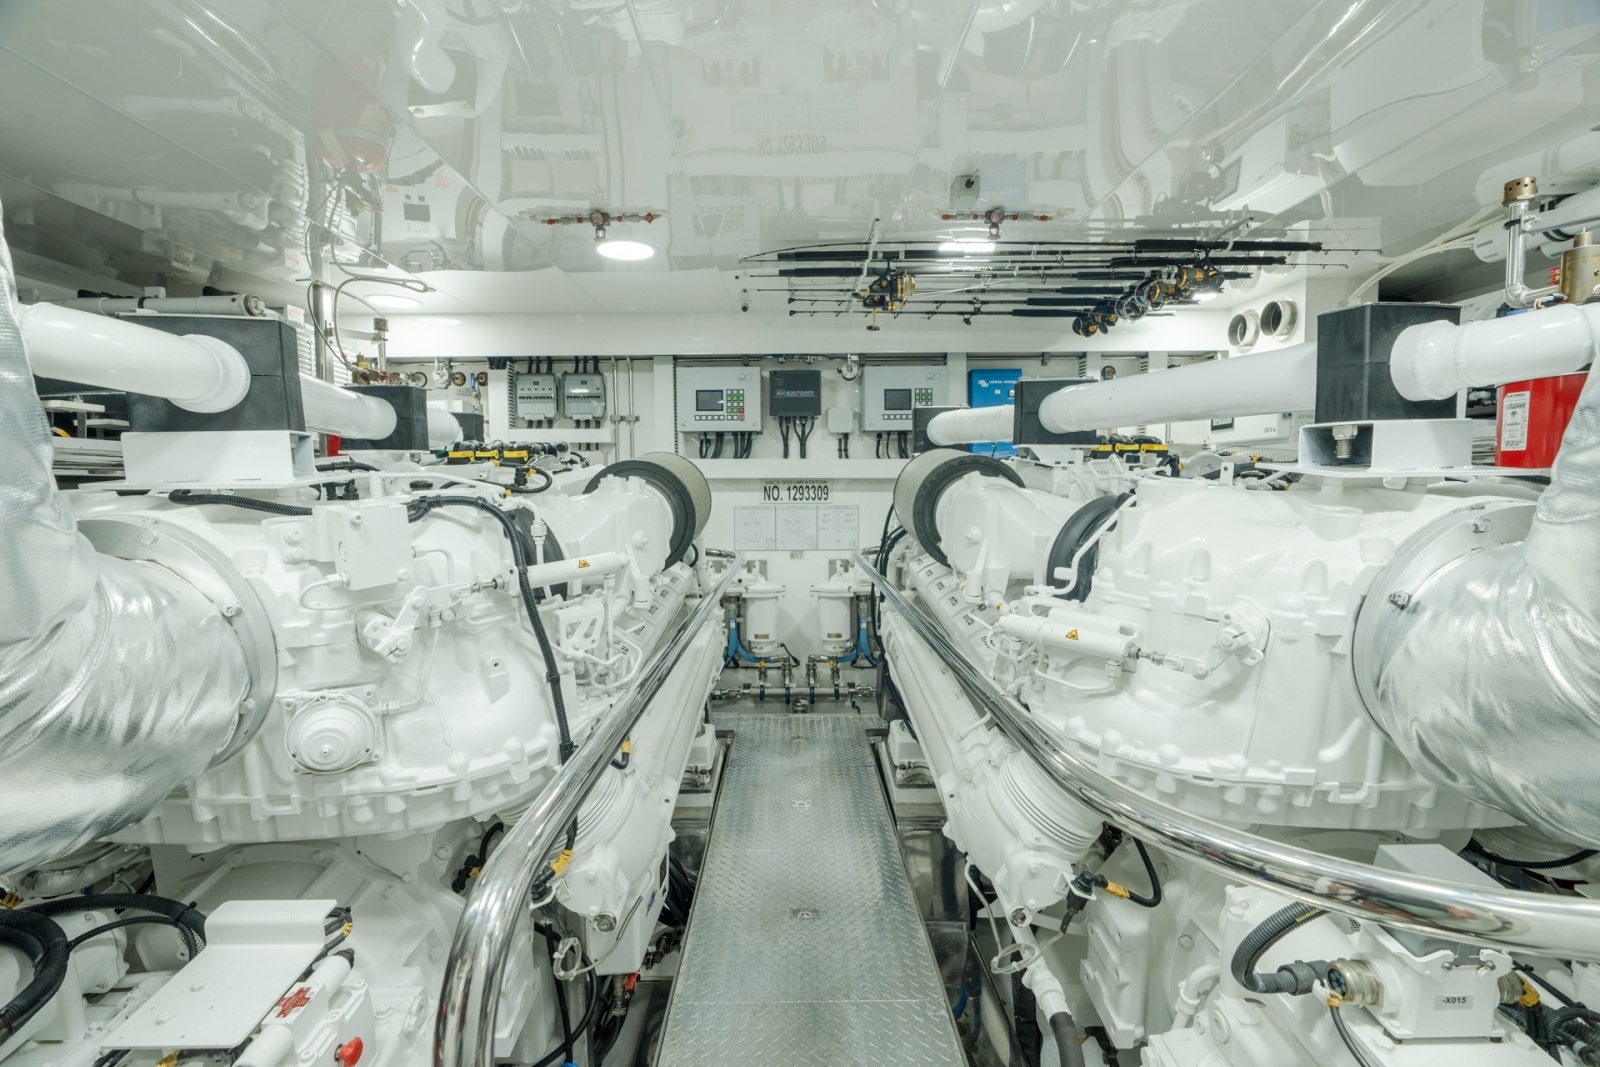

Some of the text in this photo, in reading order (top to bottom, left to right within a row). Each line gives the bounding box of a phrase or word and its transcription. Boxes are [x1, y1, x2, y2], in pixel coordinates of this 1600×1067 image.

[763, 485, 829, 501] NO. 1293309
[1442, 996, 1467, 1004] -X015
